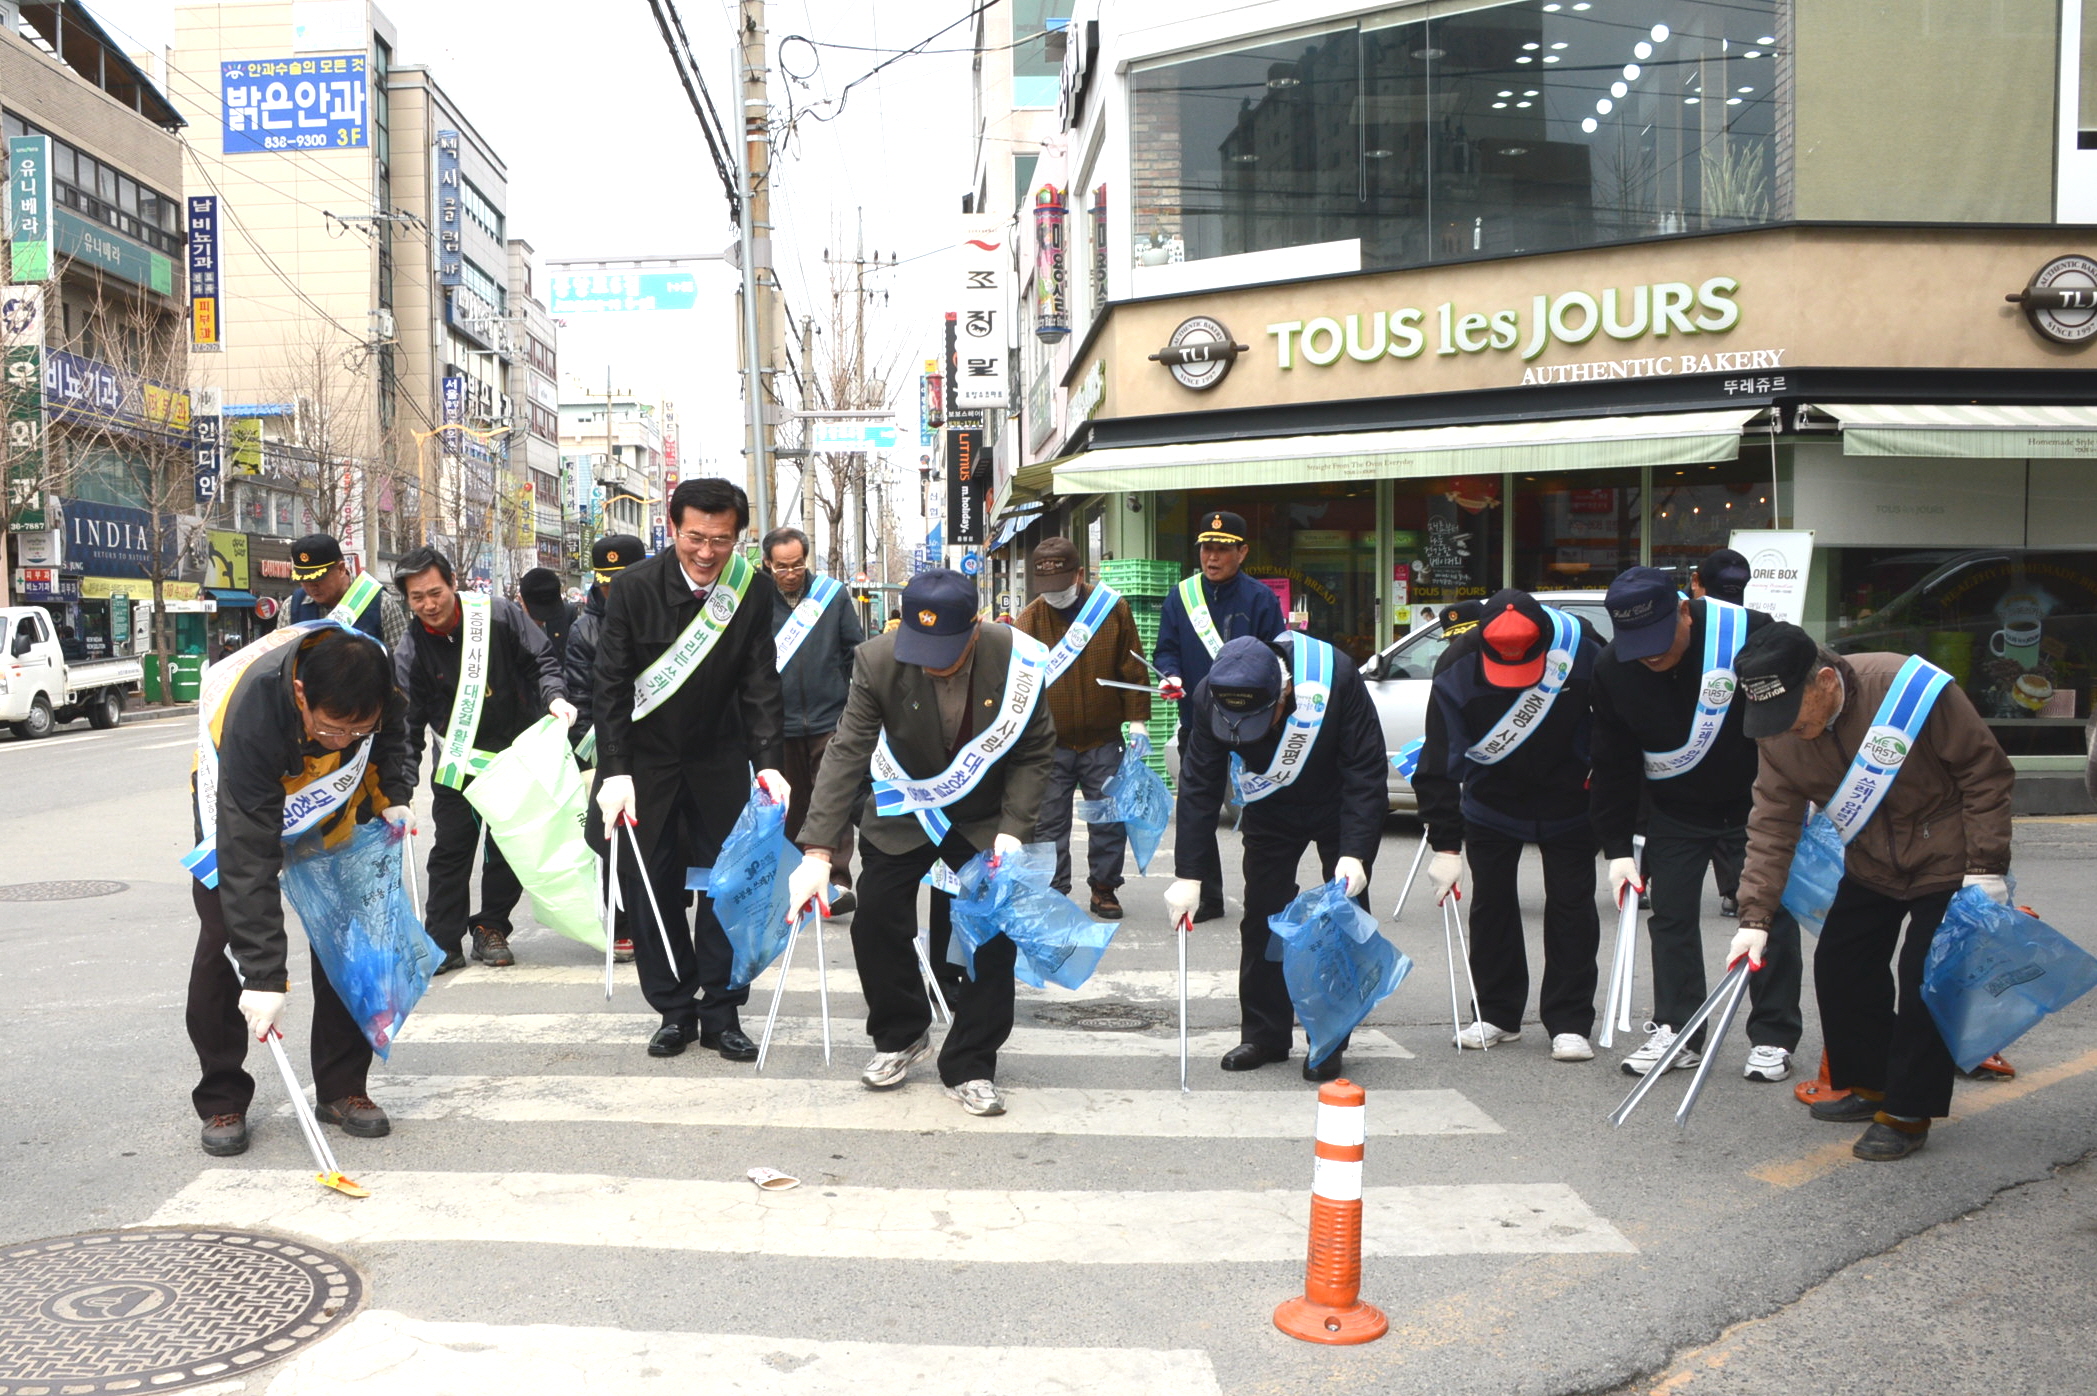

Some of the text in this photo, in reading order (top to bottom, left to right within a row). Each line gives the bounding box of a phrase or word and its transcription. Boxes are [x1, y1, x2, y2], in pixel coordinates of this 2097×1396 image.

[248, 58, 365, 77] 안과수술의 모든 것
[227, 80, 365, 132] 밝은안과
[337, 128, 361, 147] 3F
[20, 159, 39, 235] 유니베라
[192, 199, 212, 214] 남
[84, 232, 120, 266] 유니베라
[192, 217, 213, 269] 비뇨기과
[2040, 261, 2077, 286] AUTHENTIC
[1174, 321, 1223, 345] AUTHENTIC BAKERY
[1267, 276, 1741, 371] TOUS les JOURS
[2048, 321, 2096, 338] SINCE 1997
[1520, 348, 1786, 386] AUTHENTIC BAKERY
[1724, 376, 1787, 395] 뚜레쥬르
[2028, 438, 2074, 446] Homemade
[197, 422, 216, 496] 인디안
[74, 517, 164, 552] INDIA
[1778, 569, 1799, 580] BOX
[1304, 575, 1337, 606] BREAD
[1413, 587, 1439, 596] TOUS
[1455, 586, 1487, 597] JOURS
[708, 597, 728, 616] FIRST
[449, 611, 484, 758] 증평 사랑 대청결 활동
[646, 665, 678, 696] 쓰레기
[1703, 688, 1727, 698] FIRST
[980, 719, 1018, 754] 사랑
[1485, 729, 1518, 754] 사랑
[1693, 721, 1714, 748] 쓰레기
[1871, 736, 1891, 748] ME
[1863, 742, 1897, 759] FIRST
[933, 752, 985, 799] 대청결
[1849, 777, 1877, 804] 쓰레기
